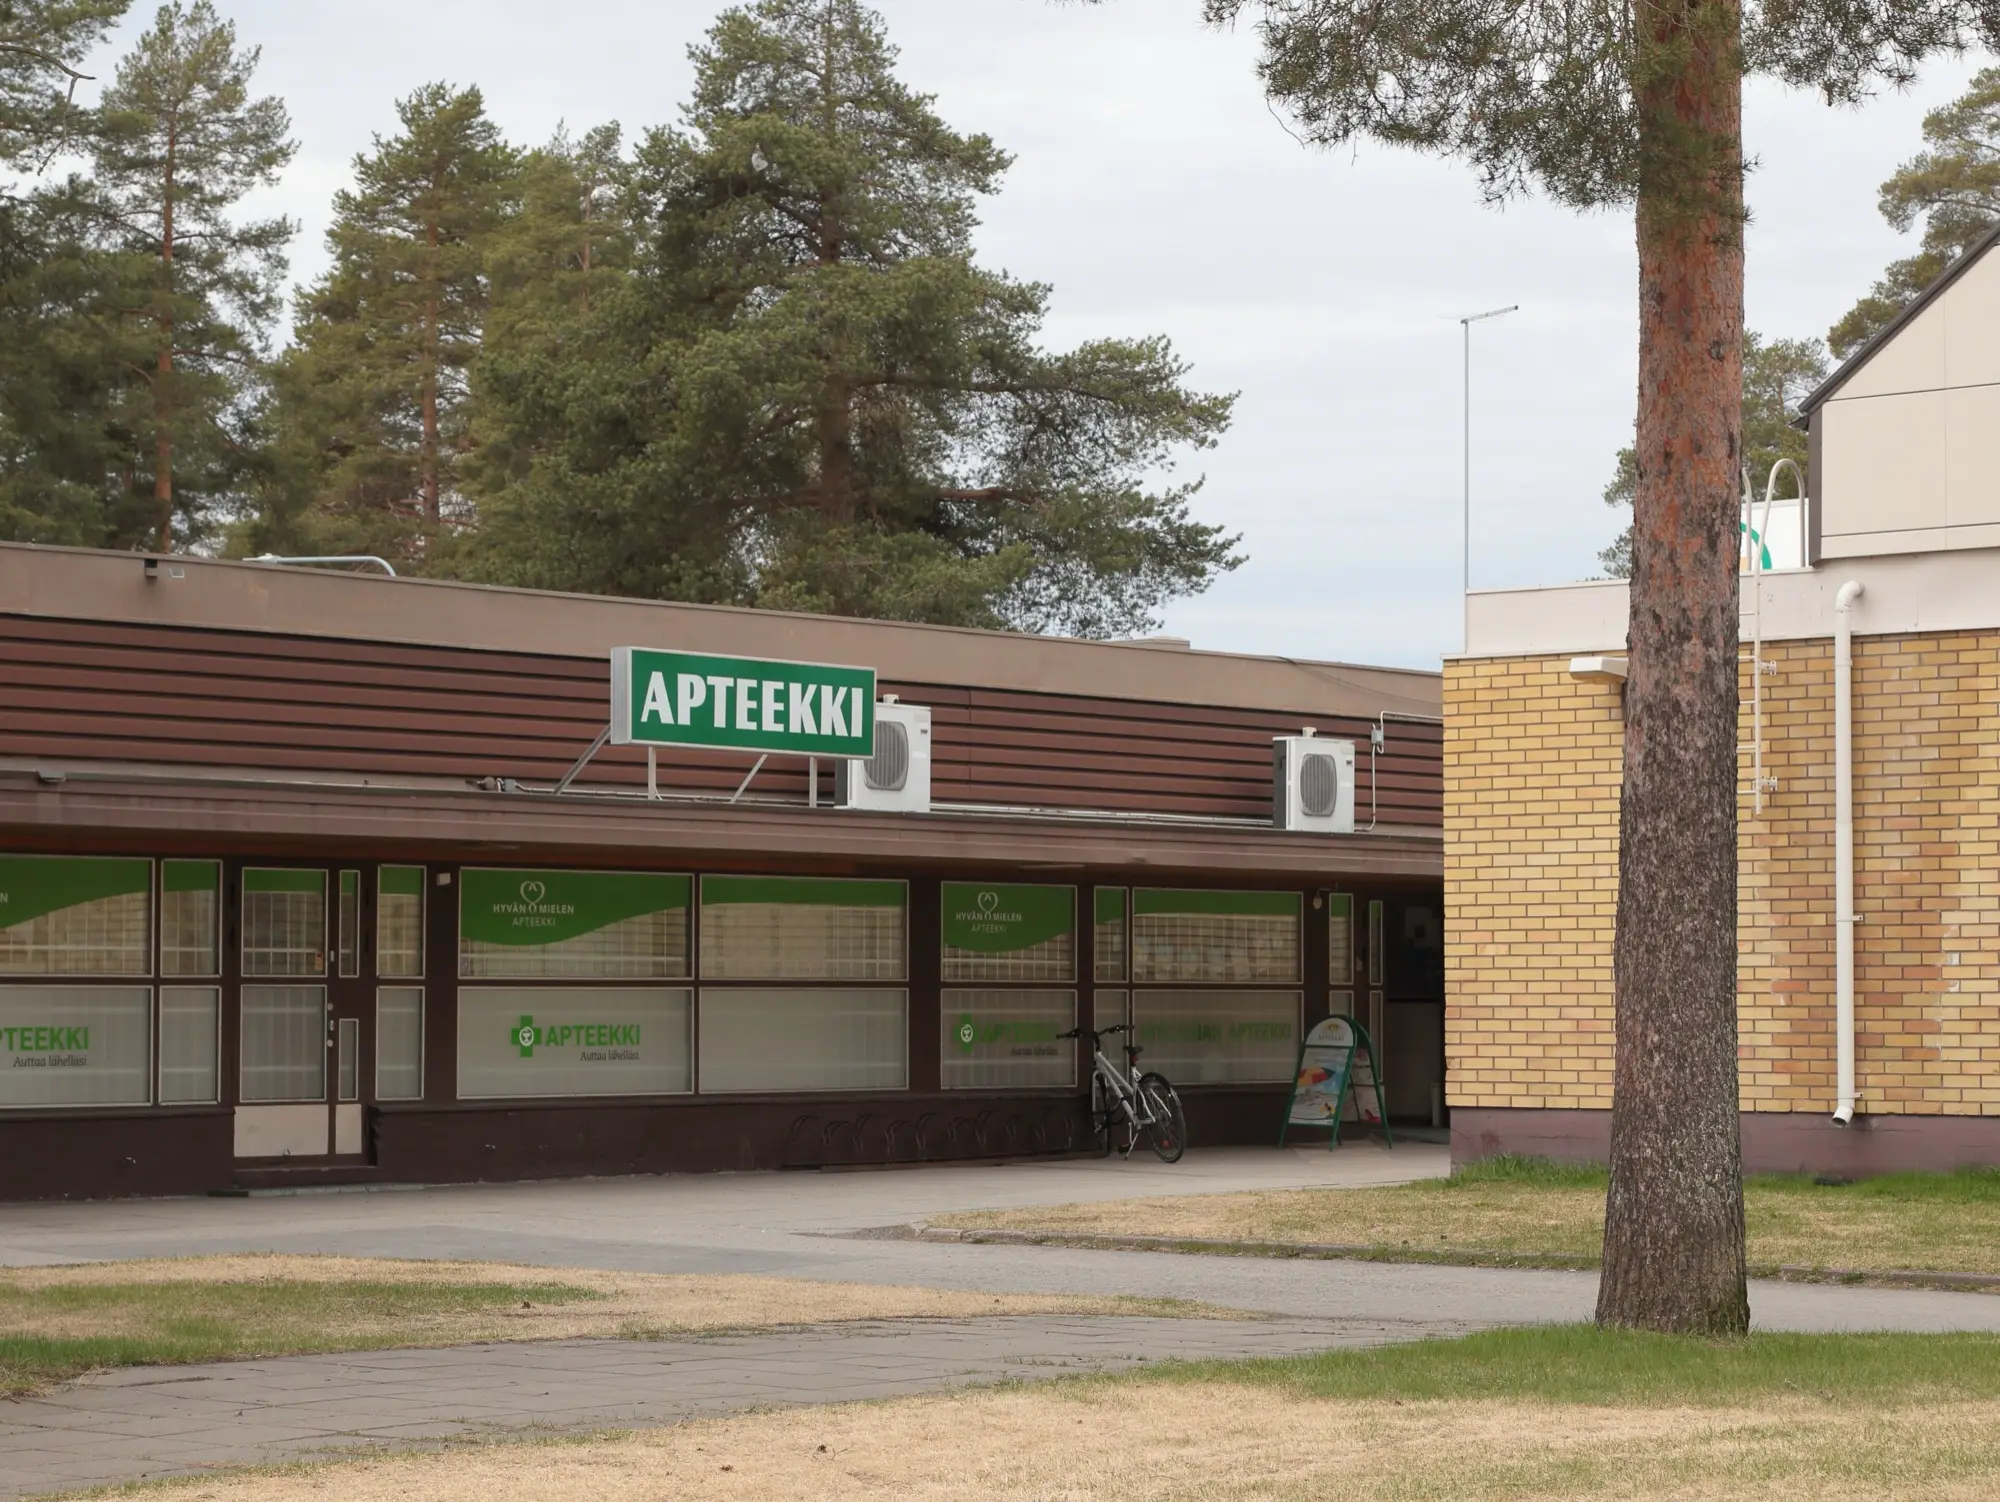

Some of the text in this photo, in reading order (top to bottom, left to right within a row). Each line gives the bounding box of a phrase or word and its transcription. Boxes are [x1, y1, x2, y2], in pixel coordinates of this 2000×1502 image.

[640, 671, 864, 738] APTEEKKI
[493, 902, 574, 914] HYVÄN MIELEN
[512, 916, 556, 927] APTEEKKI
[545, 1024, 640, 1047] APTEEKKI
[13, 1056, 46, 1068] Auttaa
[580, 1051, 607, 1061] Auttaa
